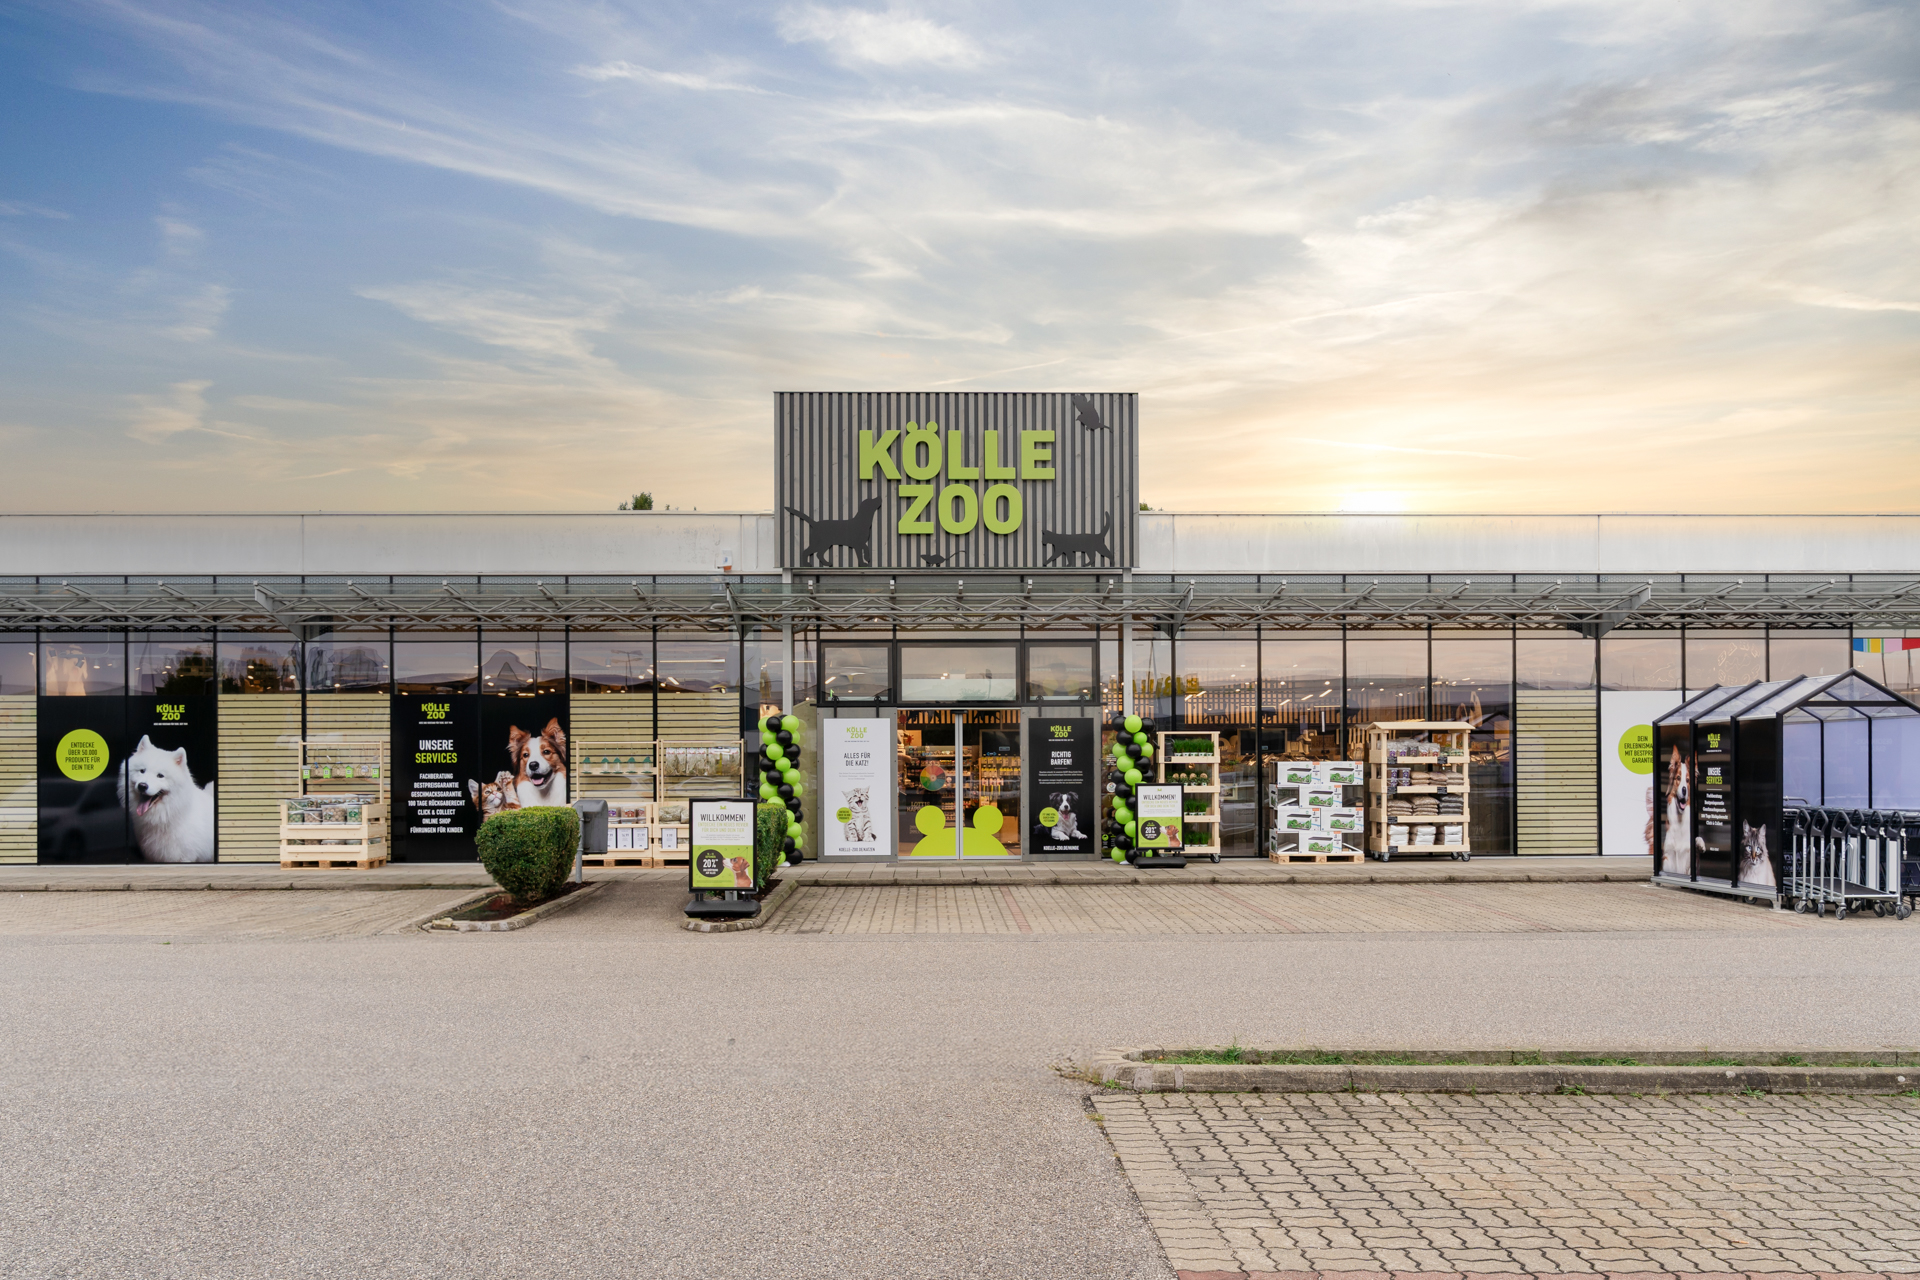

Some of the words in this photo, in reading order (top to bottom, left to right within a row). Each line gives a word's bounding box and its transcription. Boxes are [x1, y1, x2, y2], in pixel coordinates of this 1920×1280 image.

[859, 421, 1055, 480] KÖLLE
[898, 483, 1023, 535] ZOO
[156, 704, 185, 713] KÖLLE
[421, 702, 450, 712] KÖLLE
[161, 712, 181, 720] ZOO
[426, 711, 446, 720] ZOO
[419, 739, 454, 751] UNSERE
[415, 752, 458, 764] SERVICES
[860, 751, 871, 759] FÜR
[1050, 758, 1073, 766] BARFEN!
[1708, 767, 1721, 775] UNSERE
[1706, 776, 1722, 784] SERVICES
[411, 790, 462, 798] GESCHMACKSGARANTIE
[428, 799, 466, 807] RÜCKGABERECHT
[417, 808, 431, 816] CLICK
[436, 808, 456, 816] COLLECT
[410, 826, 436, 834] FÜHRUNGEN
[436, 826, 446, 834] FÜR
[446, 826, 464, 834] KINDER
